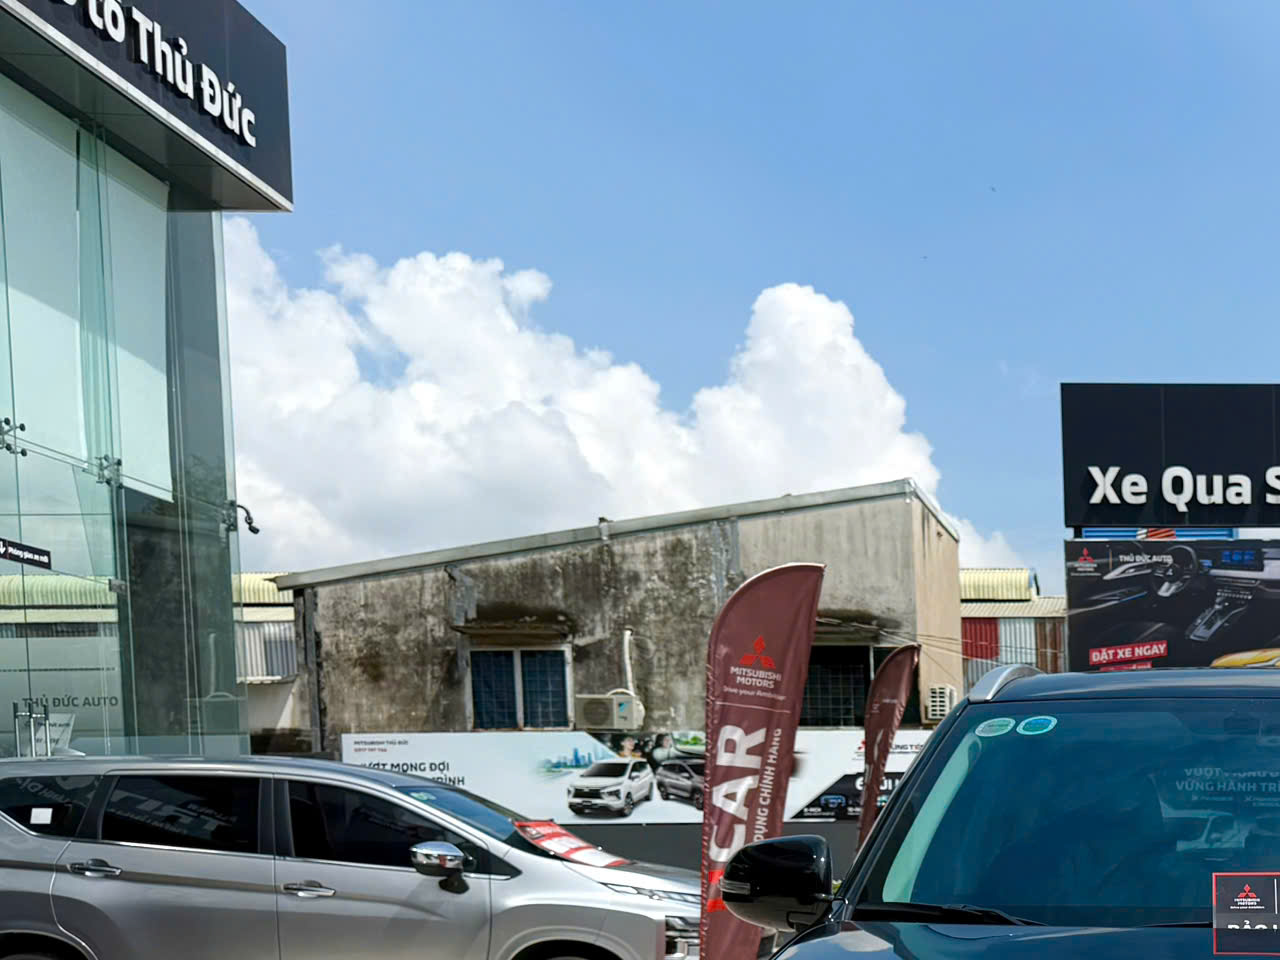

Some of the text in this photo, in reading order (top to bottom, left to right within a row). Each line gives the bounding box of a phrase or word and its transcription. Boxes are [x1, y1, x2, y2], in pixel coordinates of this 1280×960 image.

[131, 6, 194, 100] Thủ
[201, 63, 256, 147] Đức
[1087, 466, 1148, 505] Xe
[1161, 465, 1252, 512] Qua
[1092, 643, 1167, 663] ĐẶT XE NGAY
[730, 666, 782, 681] MITSUBISHI
[736, 676, 775, 689] MOTORS
[22, 693, 119, 708] THỦ ĐỨC AUTO
